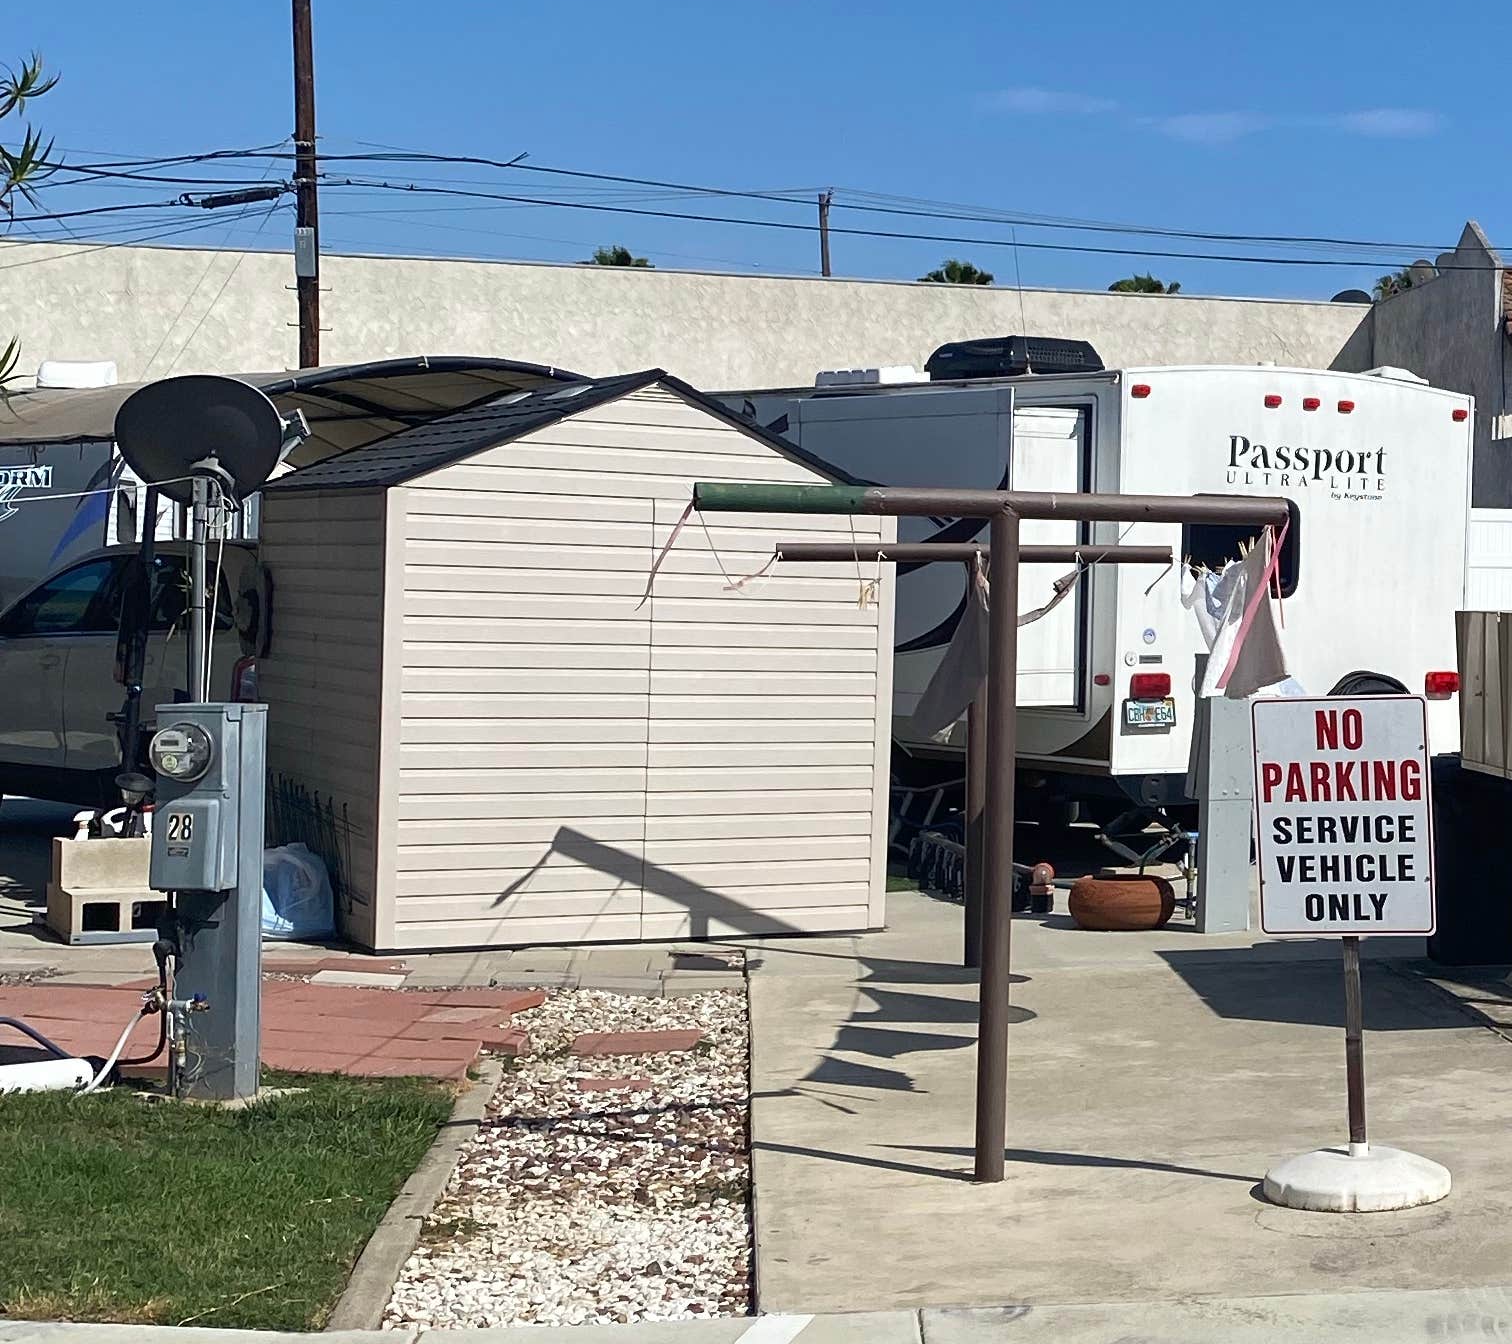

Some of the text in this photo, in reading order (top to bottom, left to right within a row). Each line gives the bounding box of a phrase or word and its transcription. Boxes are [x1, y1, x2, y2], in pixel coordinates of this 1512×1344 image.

[1227, 434, 1388, 481] Passport
[1226, 470, 1385, 491] ULTRA LITE
[1315, 709, 1363, 751] NO
[1262, 759, 1422, 803] PARKING
[169, 814, 192, 841] 28
[1272, 815, 1416, 845] SERVICE
[1276, 854, 1416, 883] VEHICLE
[1305, 893, 1388, 922] ONLY
